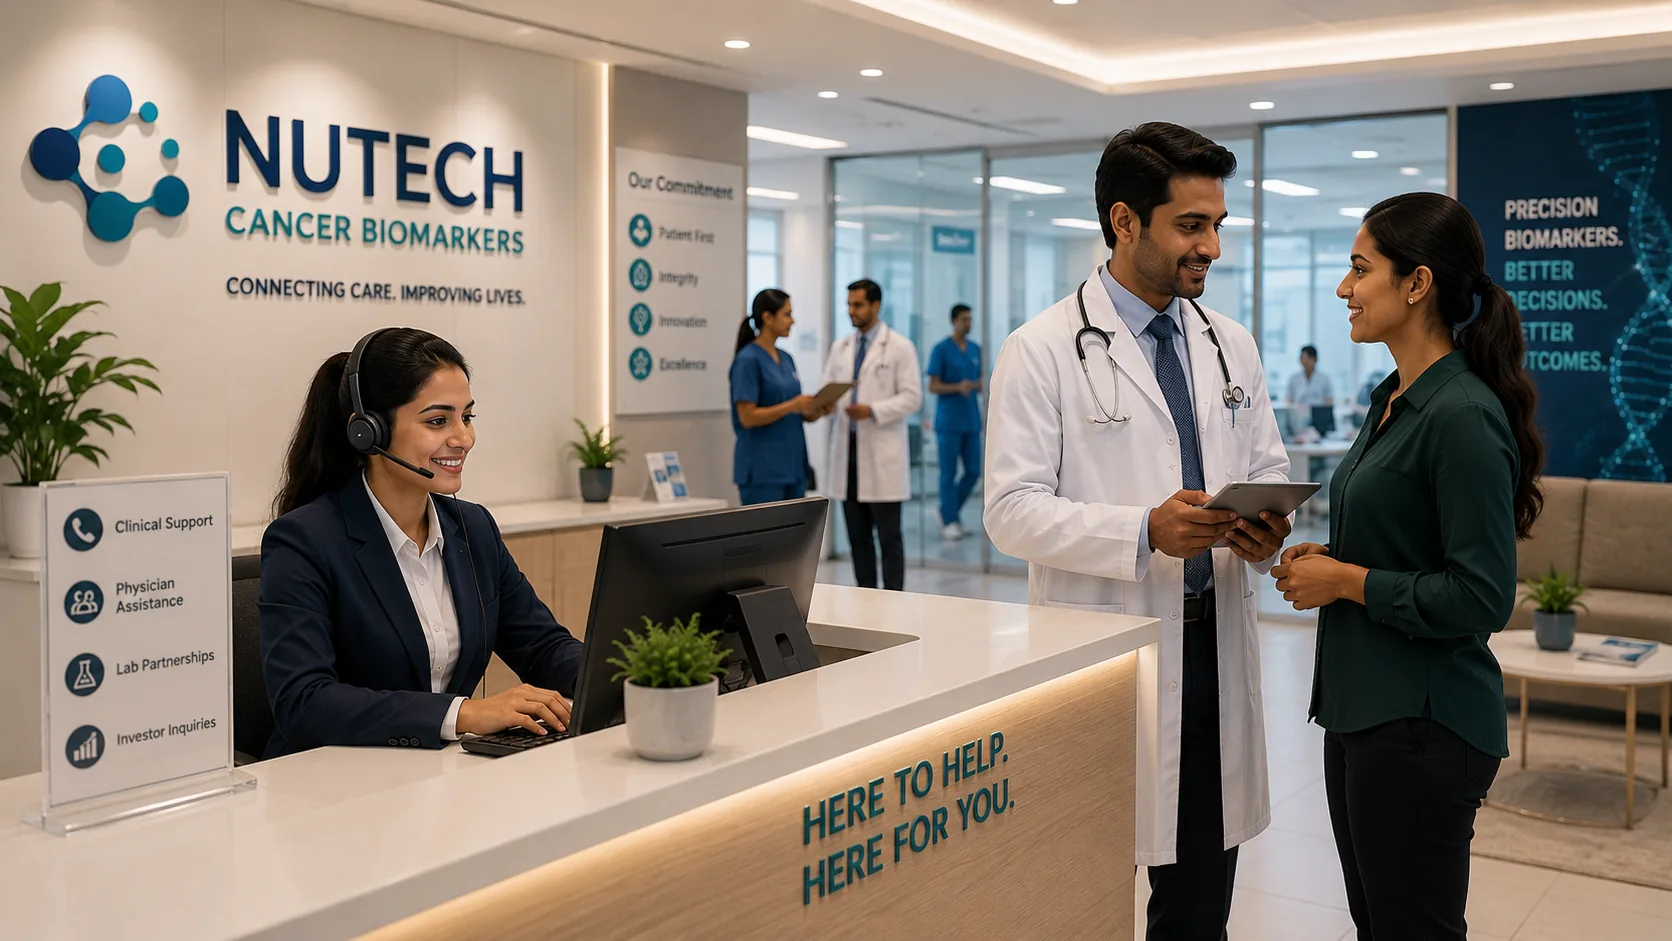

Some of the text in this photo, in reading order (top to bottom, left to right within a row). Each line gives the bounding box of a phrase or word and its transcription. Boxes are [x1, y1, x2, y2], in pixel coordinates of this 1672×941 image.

[226, 109, 523, 212] NUTECH
[628, 171, 734, 200] Our Commitment
[1505, 196, 1599, 220] PRECISION
[225, 206, 524, 254] CANCER BIOMARKERS
[659, 227, 715, 244] Patient First
[1504, 226, 1624, 250] BIOMARKERS.
[659, 271, 699, 288] Integrity
[1504, 260, 1574, 282] BETTER
[226, 277, 526, 305] CONNECTING CARE. IMPROVING LIVES.
[1521, 321, 1574, 343] ETTER
[1521, 351, 1608, 372] TCOMES.
[115, 514, 214, 533] Clinical Support
[116, 579, 175, 597] Physician
[116, 595, 184, 613] Assistance
[116, 650, 215, 675] Lab Partnerships
[117, 717, 216, 745] Investor Inquiries
[803, 731, 1008, 845] HERE TO HELP.
[803, 778, 1015, 906] HERE FOR YOU.
